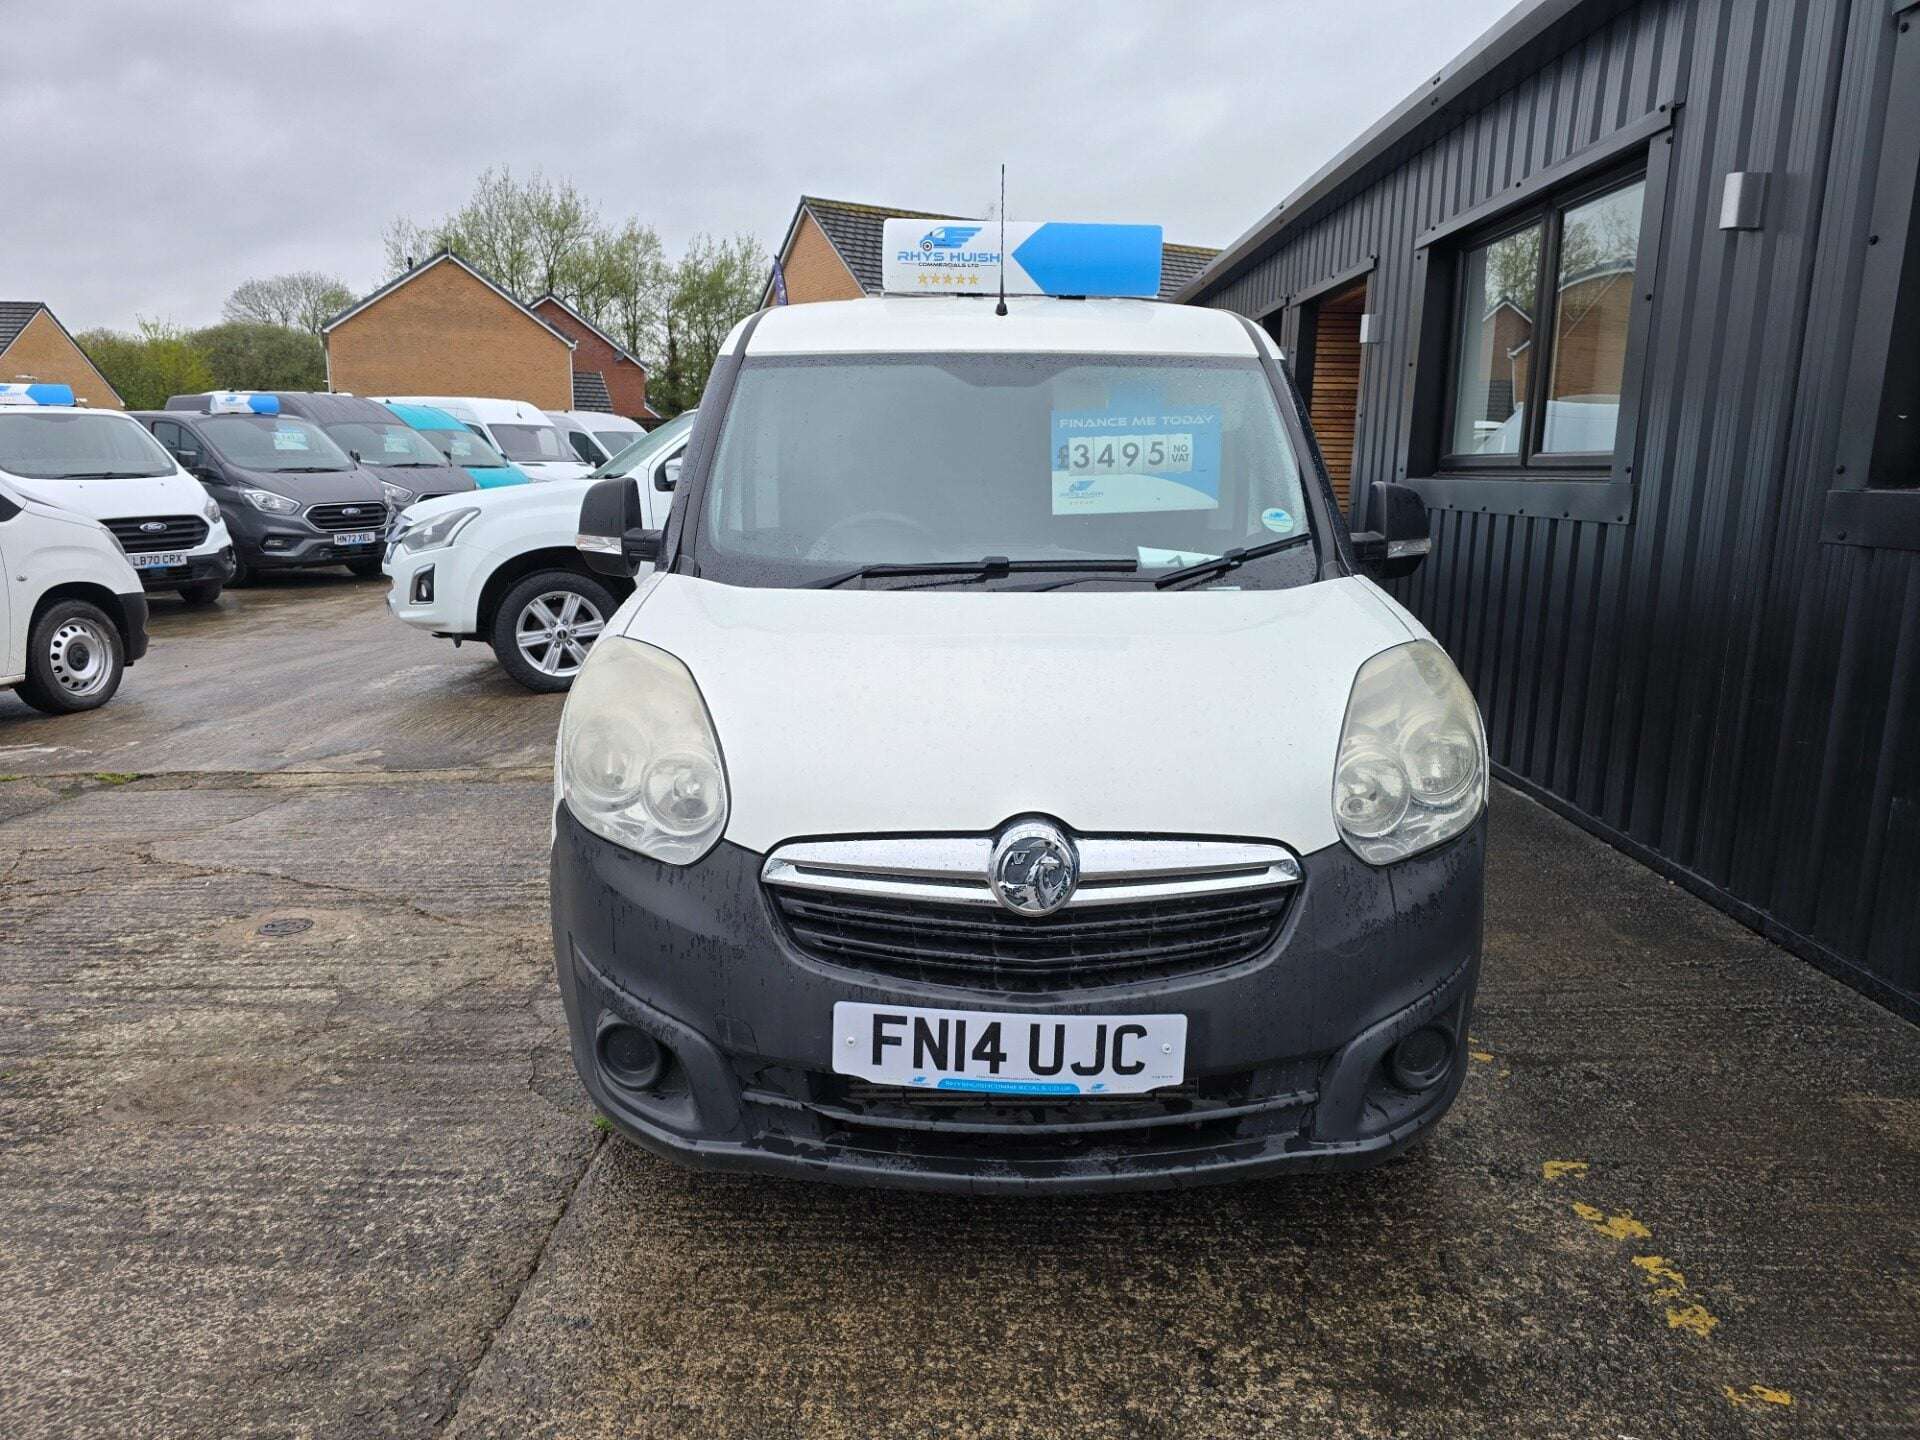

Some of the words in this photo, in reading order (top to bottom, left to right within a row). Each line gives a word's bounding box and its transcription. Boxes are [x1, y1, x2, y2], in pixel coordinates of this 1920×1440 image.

[897, 251, 944, 261] RHYS
[949, 252, 1000, 263] HUISH
[1058, 417, 1128, 428] FINANCE
[1131, 416, 1157, 426] ME
[1162, 415, 1214, 426] TODAY
[1173, 444, 1189, 452] NO
[1171, 453, 1190, 463] VAT
[336, 535, 356, 543] HN72
[132, 556, 160, 567] LB70
[162, 554, 182, 564] CRX
[872, 1013, 1007, 1074] FN14
[1028, 1024, 1148, 1077] UJC
